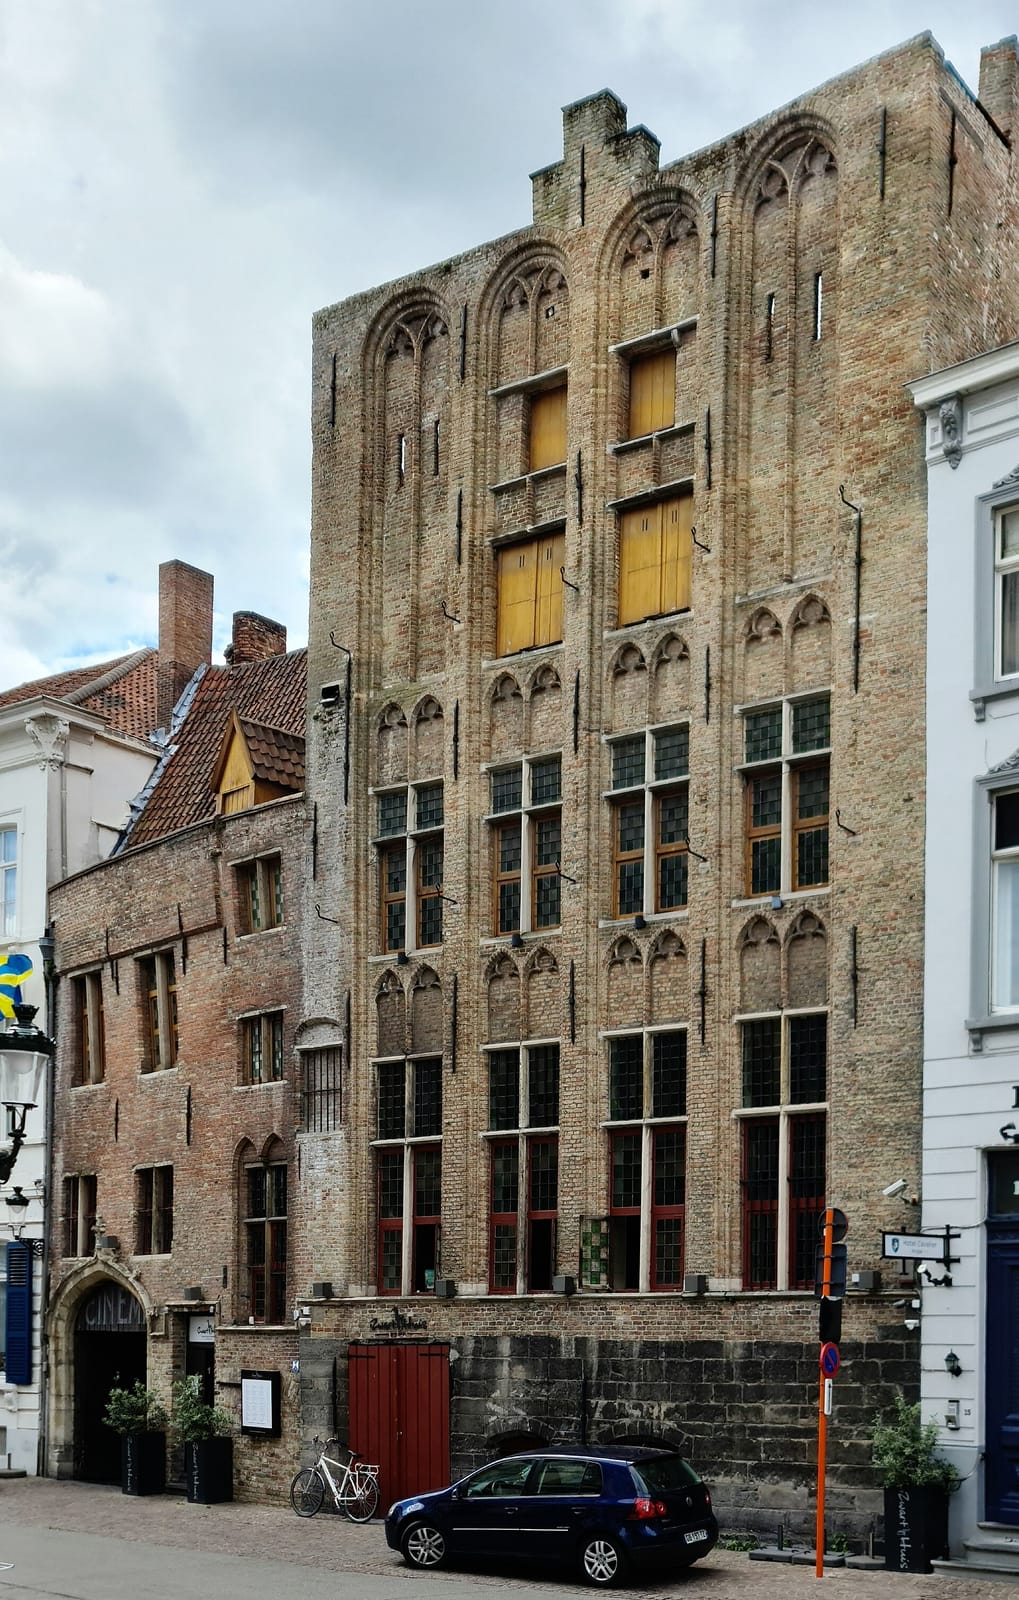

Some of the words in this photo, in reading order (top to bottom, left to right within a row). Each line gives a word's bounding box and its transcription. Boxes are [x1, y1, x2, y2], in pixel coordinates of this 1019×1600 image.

[85, 1295, 146, 1326] CINEM
[898, 1491, 910, 1527] Zwart
[900, 1537, 912, 1569] Huis
